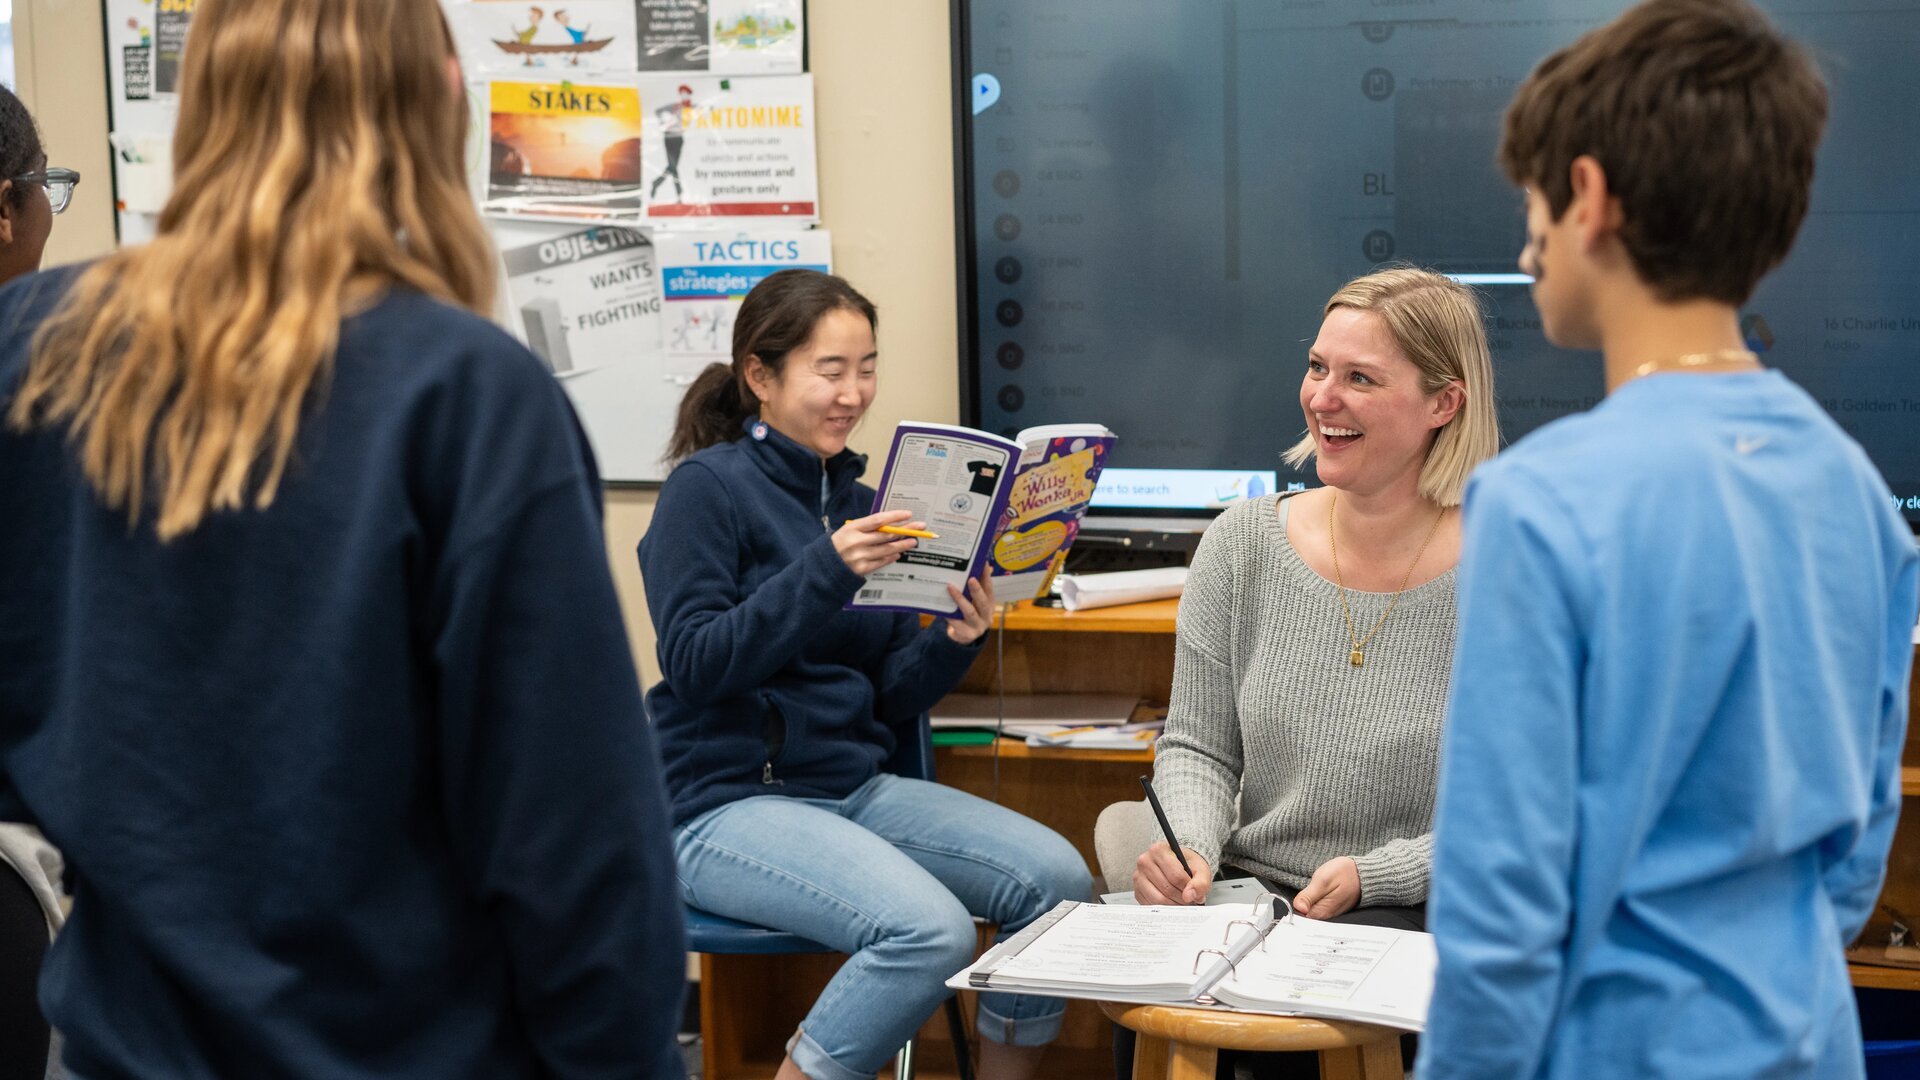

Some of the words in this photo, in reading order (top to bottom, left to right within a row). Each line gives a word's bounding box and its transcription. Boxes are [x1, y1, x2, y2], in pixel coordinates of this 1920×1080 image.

[529, 90, 611, 113] STAKES
[681, 105, 803, 129] PANTOMIME
[695, 168, 708, 180] by
[712, 168, 772, 178] movement
[776, 167, 796, 178] and
[712, 185, 754, 197] gesture
[757, 184, 781, 196] only
[693, 240, 800, 262] TACTICS
[589, 262, 653, 290] WANTS
[669, 273, 748, 293] strategies
[682, 268, 698, 277] The
[577, 298, 662, 331] FIGHTING
[1824, 317, 1839, 331] 16
[1842, 316, 1898, 331] Charlie
[1842, 399, 1897, 412] Golden
[1022, 472, 1068, 497] Willy
[1117, 484, 1129, 496] to
[1131, 483, 1170, 496] search
[1016, 487, 1072, 514] Wonka
